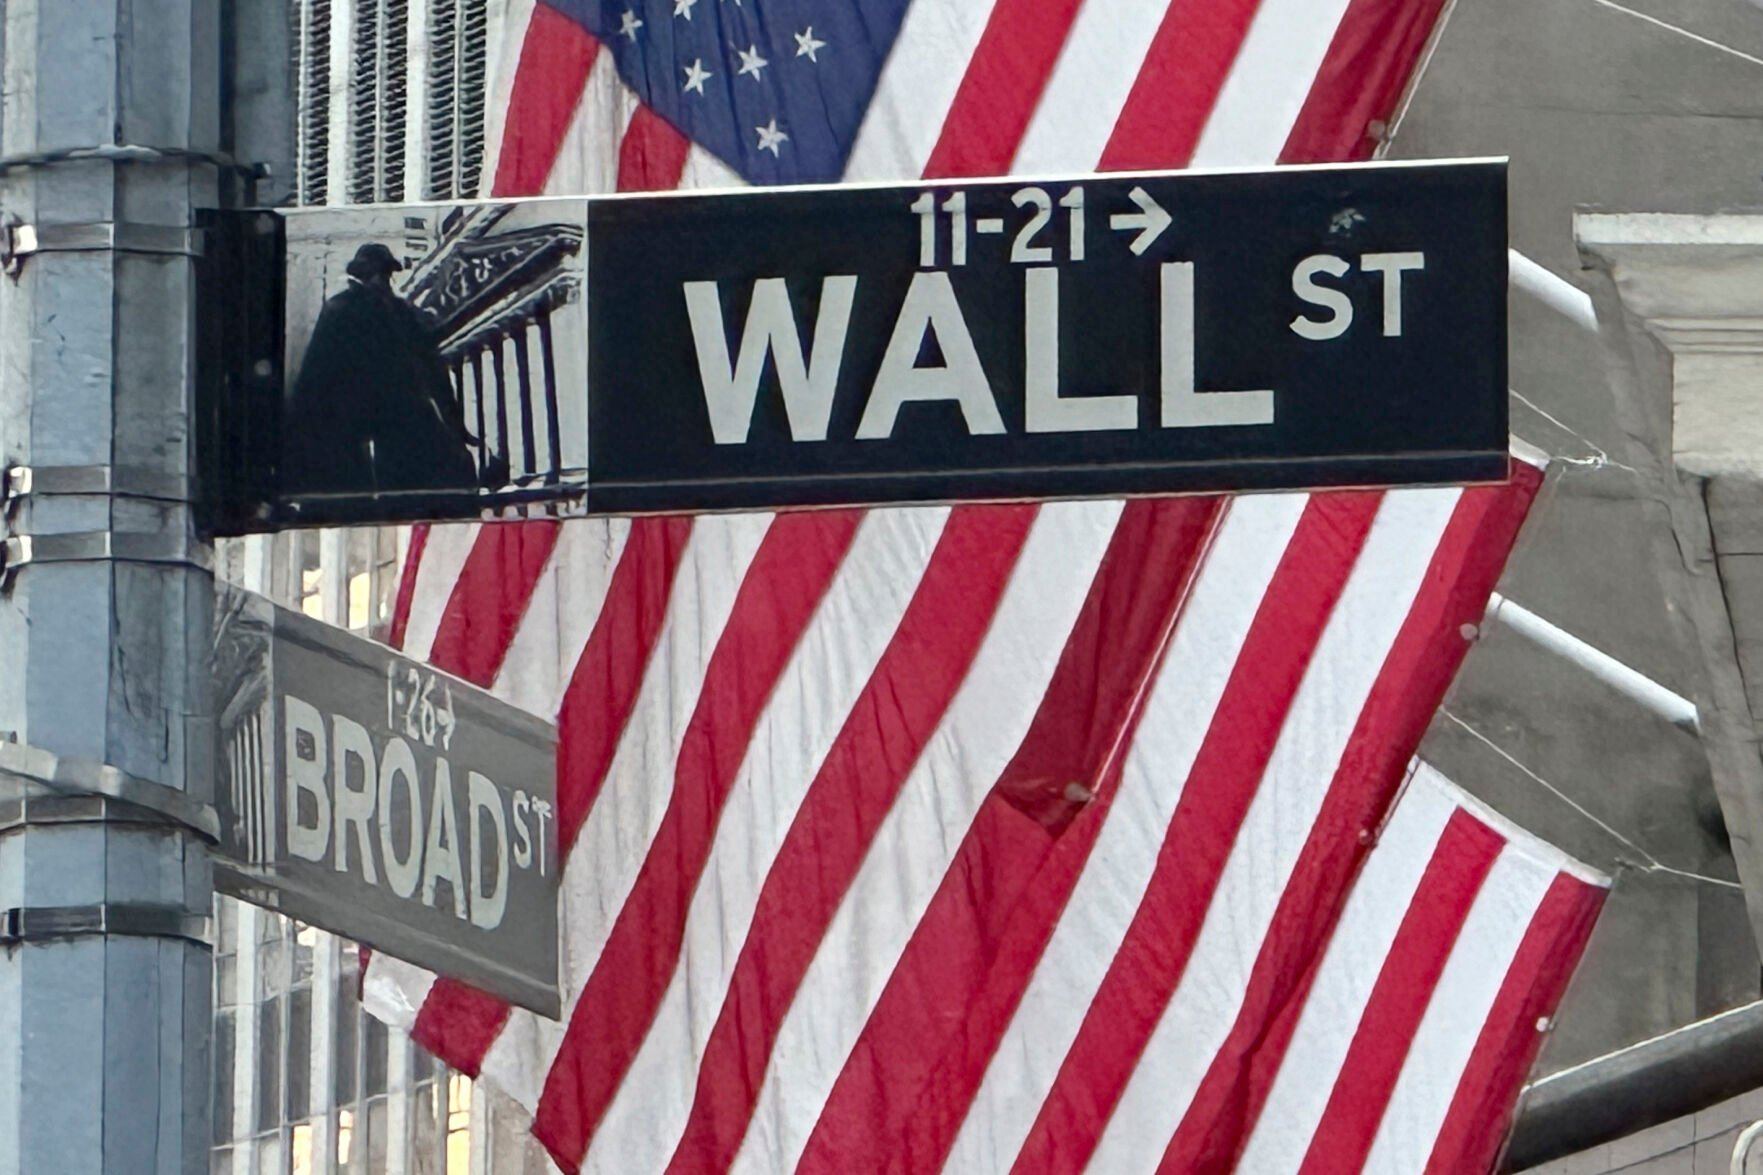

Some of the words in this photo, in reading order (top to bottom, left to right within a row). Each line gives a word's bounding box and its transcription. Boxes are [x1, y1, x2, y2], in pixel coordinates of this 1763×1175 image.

[911, 187, 1086, 267] 11-21
[683, 261, 1275, 445] WALL
[1289, 251, 1425, 342] ST
[387, 660, 436, 747] 1-26
[285, 695, 509, 930] BROAD
[513, 789, 552, 877] ST
